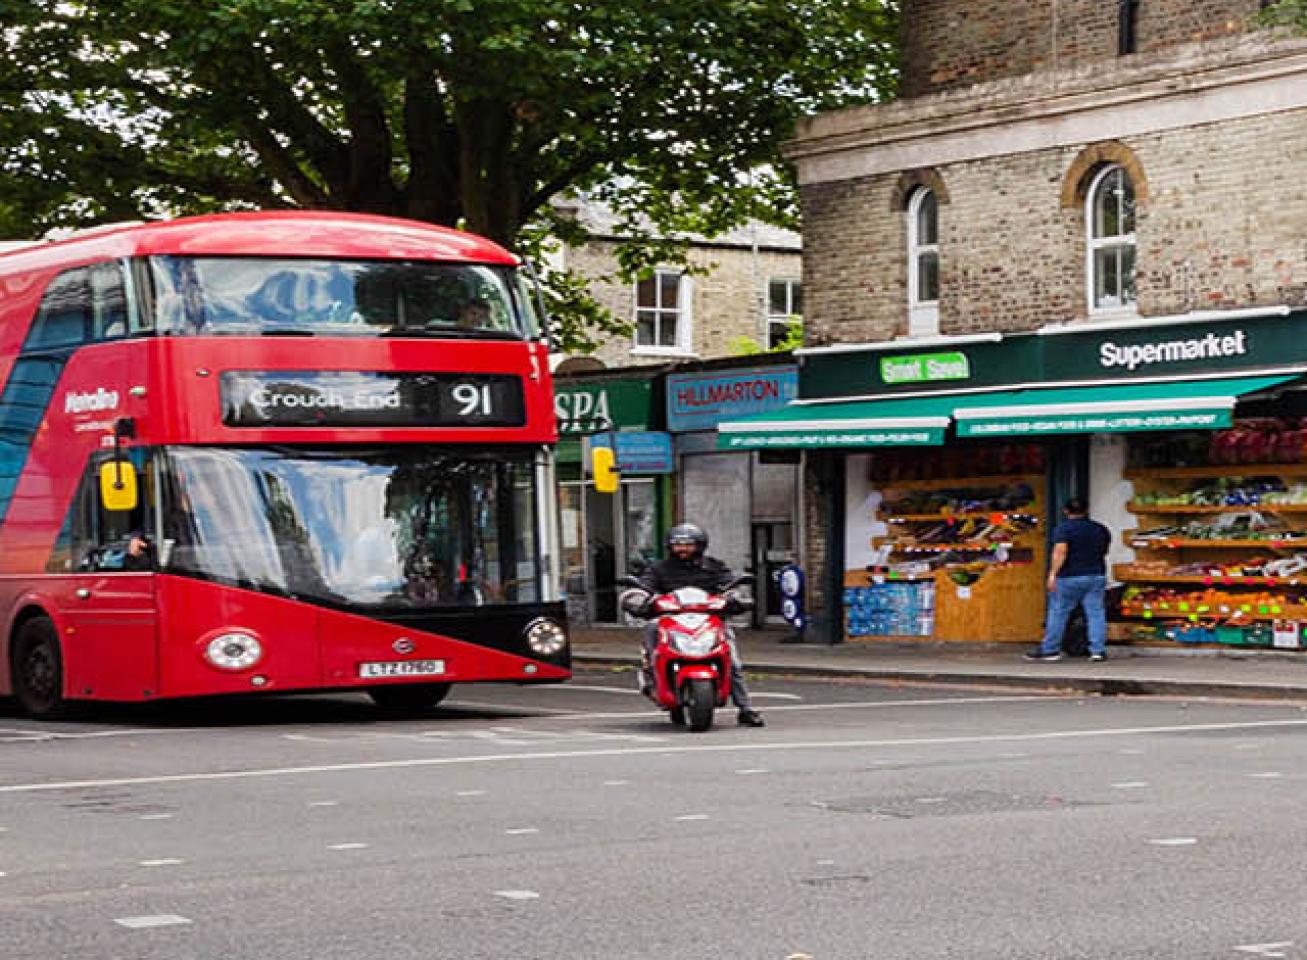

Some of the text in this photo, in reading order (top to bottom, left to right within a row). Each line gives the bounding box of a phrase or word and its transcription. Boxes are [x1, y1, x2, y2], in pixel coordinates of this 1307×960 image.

[1100, 330, 1248, 370] Supermarket
[250, 386, 401, 410] Crouch End
[450, 382, 492, 417] 91
[677, 379, 780, 407] HILLMARTON
